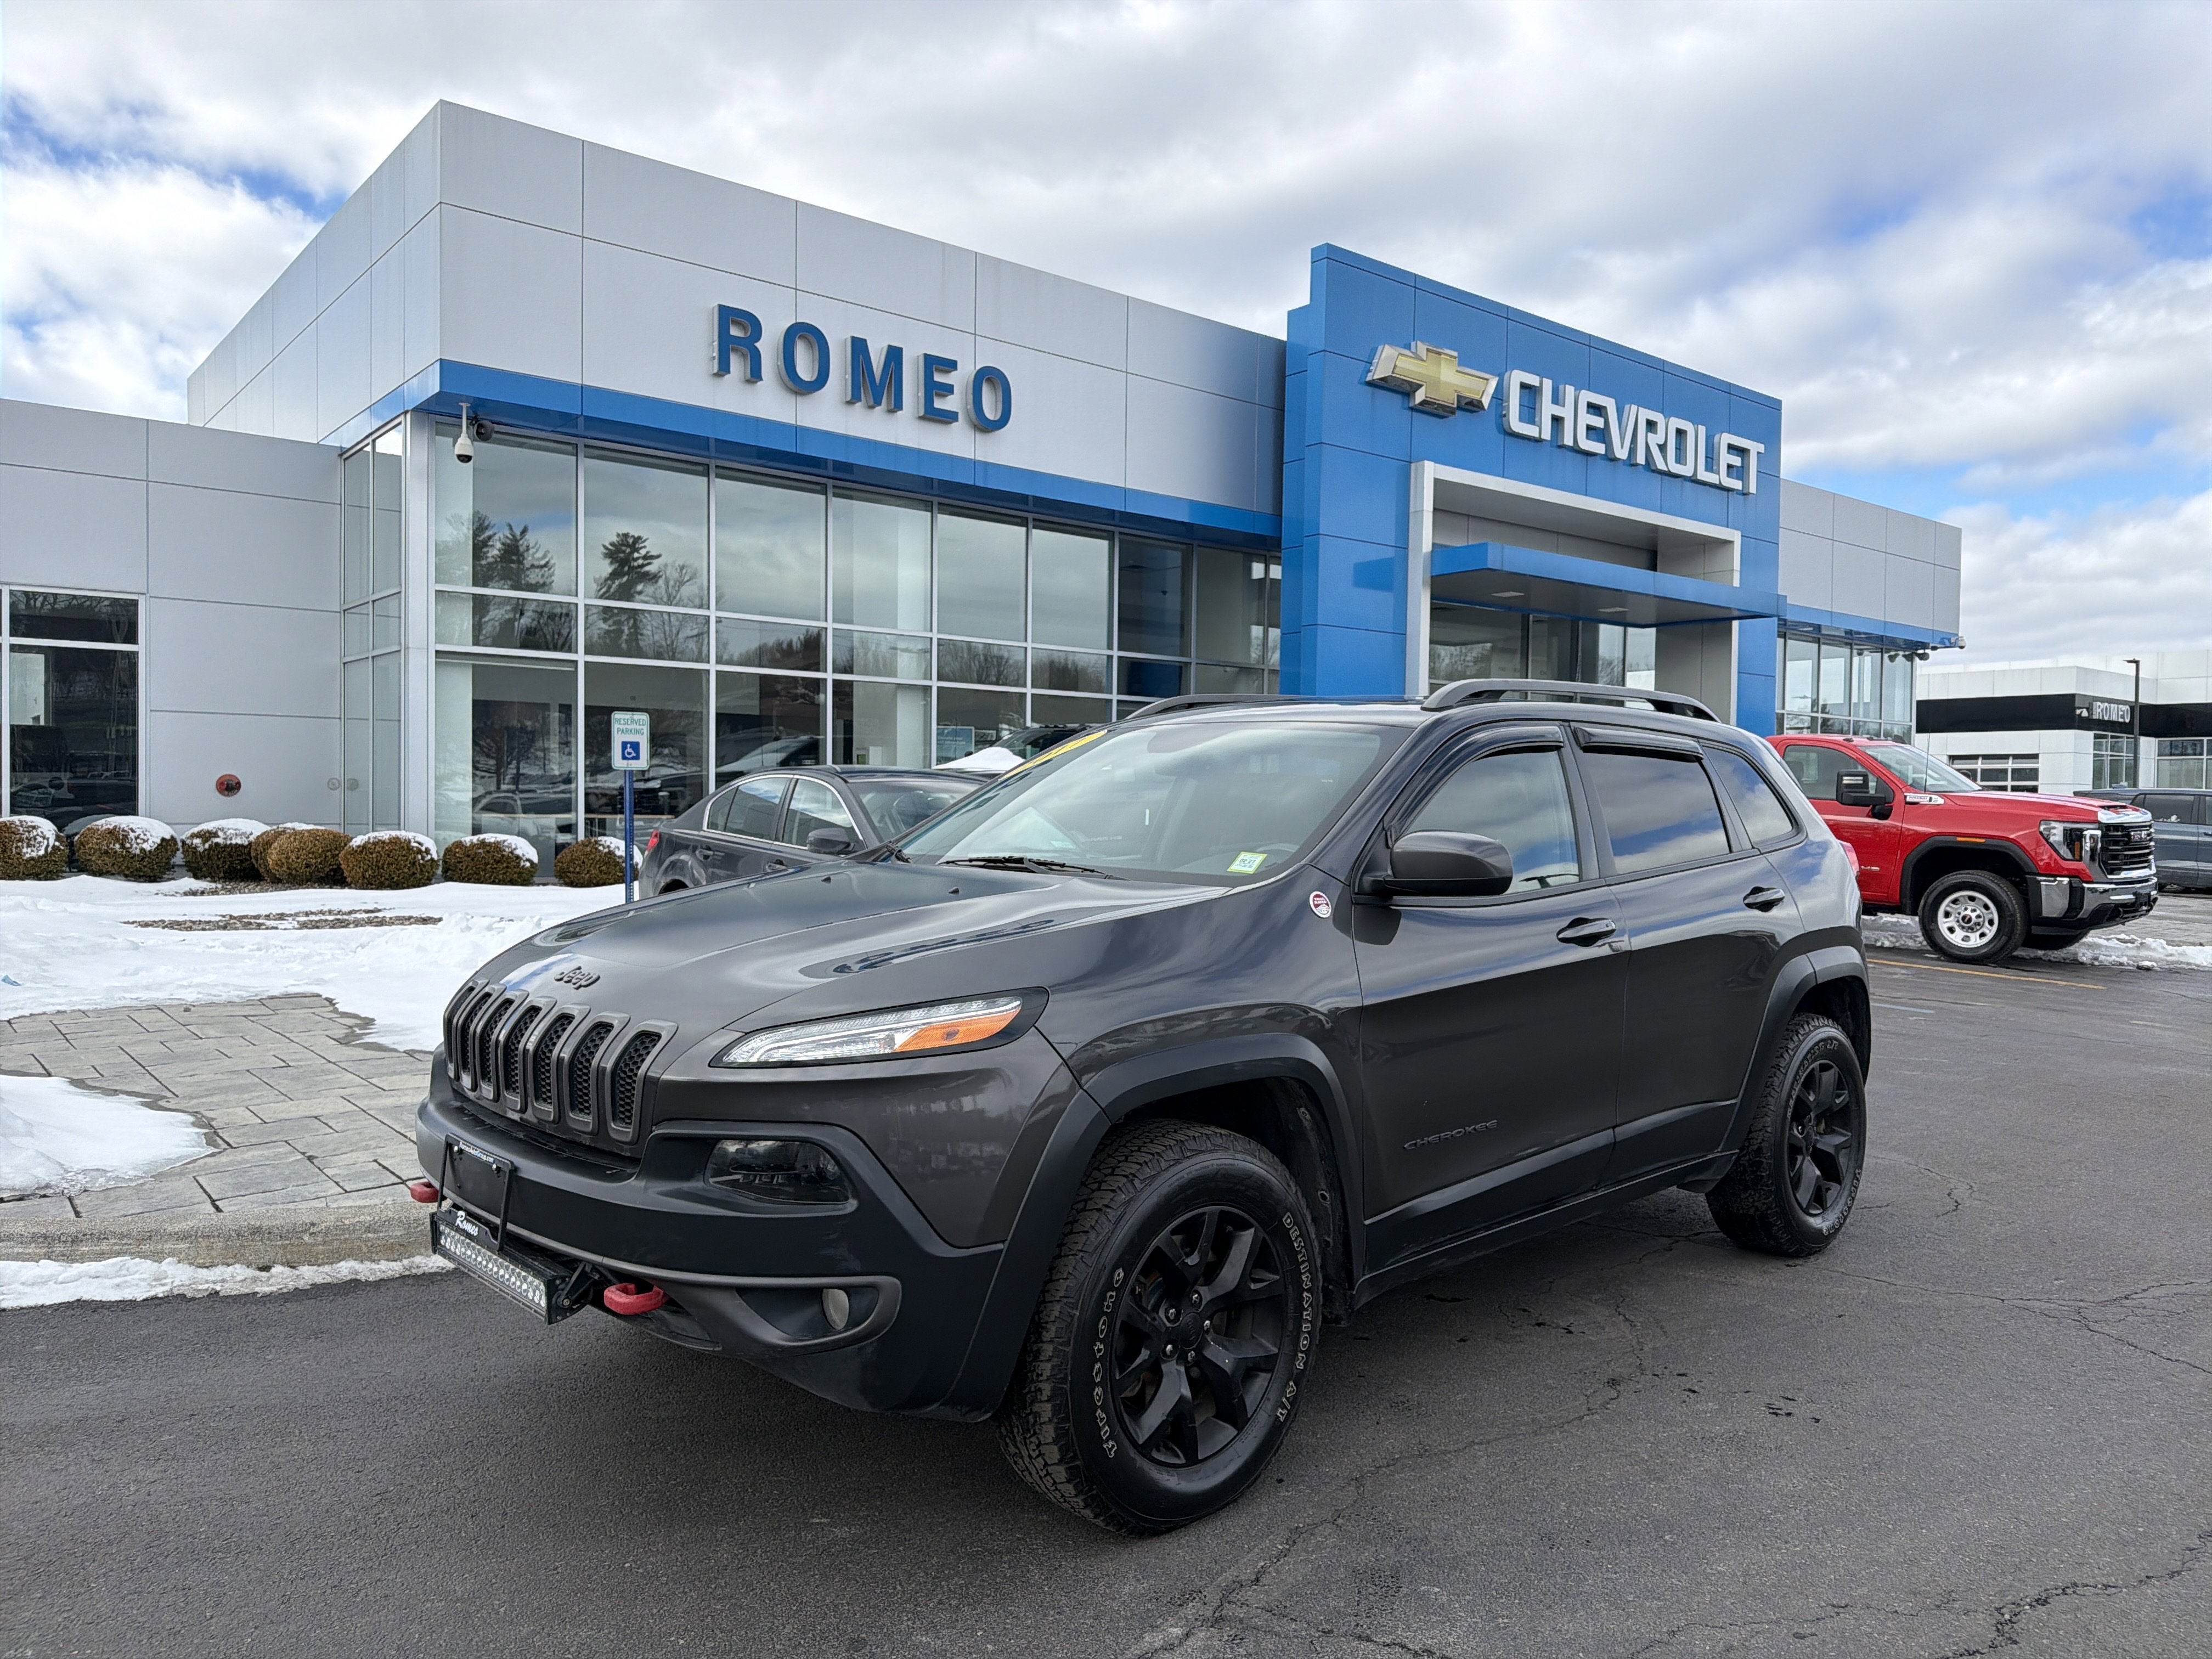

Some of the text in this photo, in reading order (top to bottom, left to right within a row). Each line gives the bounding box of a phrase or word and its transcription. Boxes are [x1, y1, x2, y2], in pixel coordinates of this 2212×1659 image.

[713, 303, 1012, 432] ROMEO
[1503, 369, 1765, 495] CHEVROLET
[614, 718, 646, 726] RESERVED
[2093, 702, 2131, 723] ROMEO
[617, 727, 645, 736] PARKING
[554, 966, 601, 990] Jeep
[1403, 1120, 1498, 1150] CHEROKEE
[455, 1210, 478, 1237] Romeo
[1277, 1211, 1312, 1422] DESTINATION A/T
